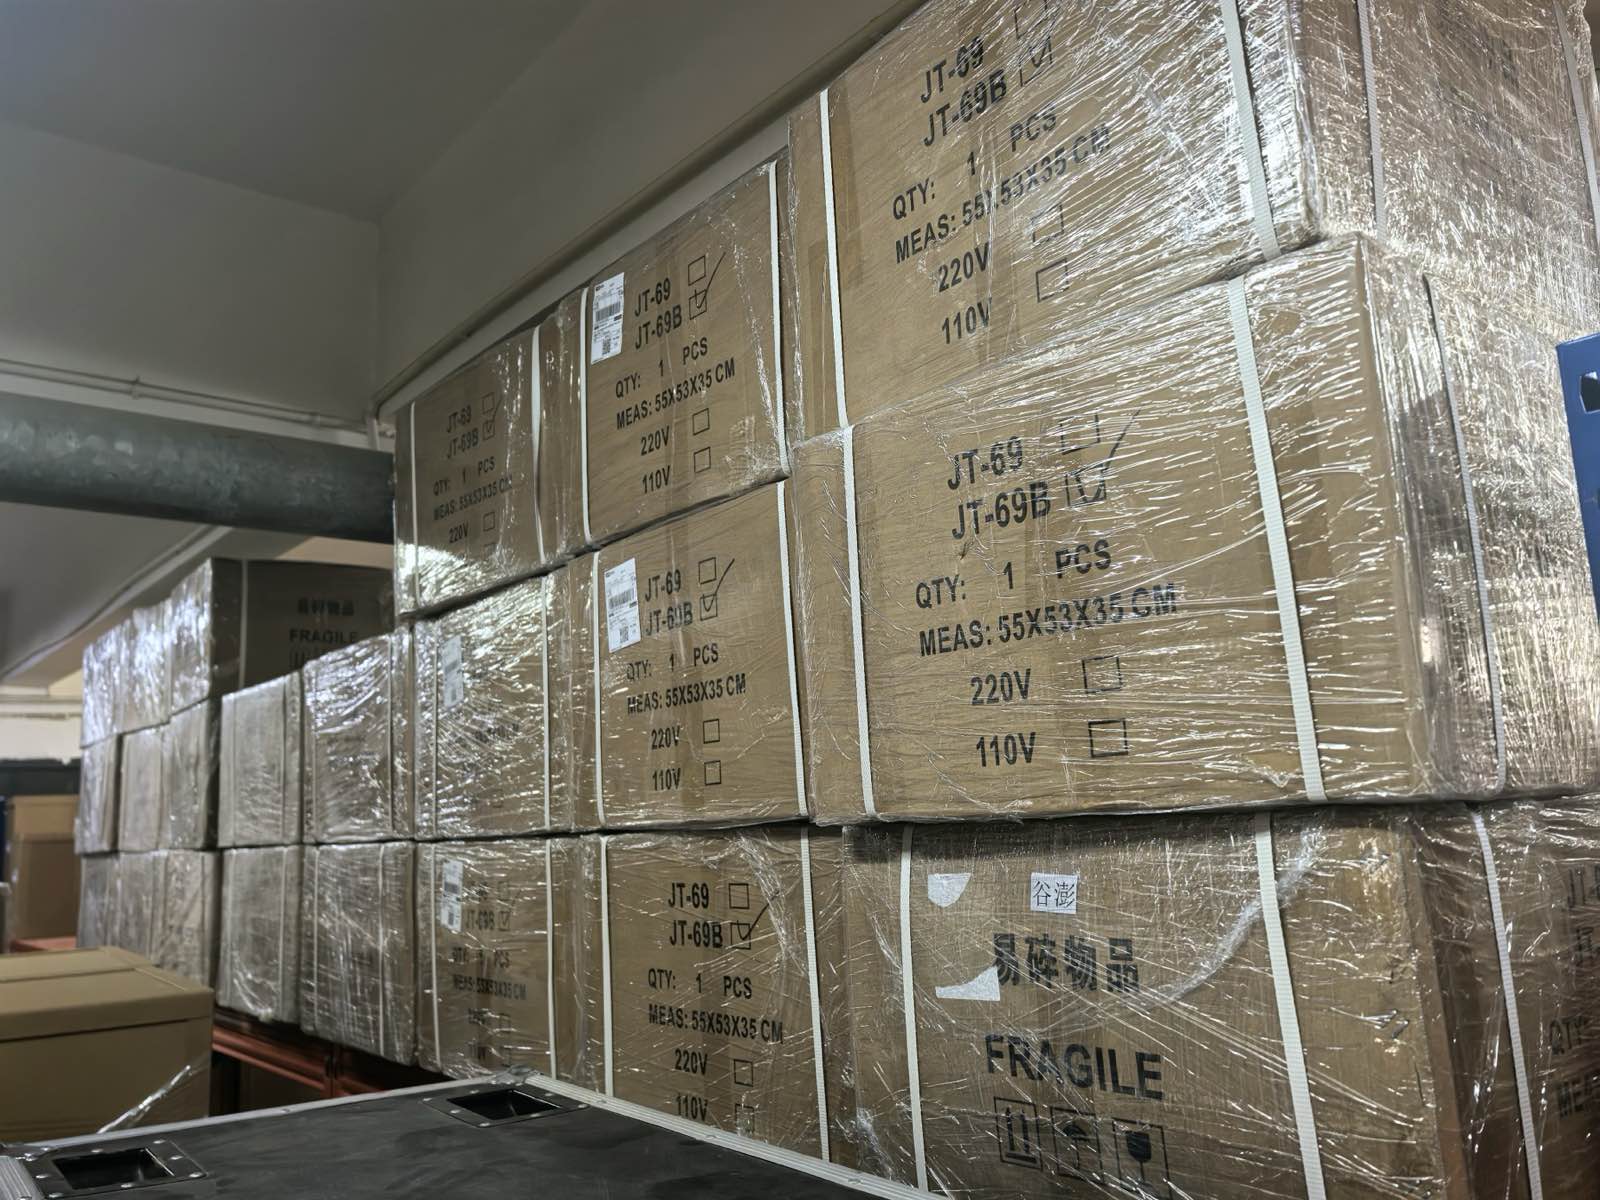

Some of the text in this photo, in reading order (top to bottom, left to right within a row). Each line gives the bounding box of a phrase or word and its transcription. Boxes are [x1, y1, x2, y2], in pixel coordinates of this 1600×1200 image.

[921, 36, 985, 103] JT-69
[923, 69, 1007, 147] JT-69B
[892, 105, 1056, 220] QTY: 1 PCS
[895, 213, 955, 264] MEAS:
[1072, 123, 1112, 164] CM
[938, 242, 989, 293] 220V
[634, 277, 671, 318] JT-69
[635, 304, 683, 350] JT-69B
[941, 299, 990, 345] 110V
[615, 337, 708, 399] QTY: 1 PCS
[616, 358, 736, 430] MEAS: 55X53X35 CM
[447, 405, 472, 433] JT-69
[447, 428, 479, 459] JT-69B
[640, 426, 671, 456] 220V
[462, 468, 467, 483] 1
[477, 456, 496, 476] PCS
[642, 465, 671, 494] 110V
[947, 435, 1024, 490] JT-69
[951, 480, 1051, 540] JT-69B
[449, 521, 469, 543] 220V
[644, 569, 681, 602] JT-69
[915, 538, 1112, 609] QTY: 1 PCS
[919, 582, 1177, 657] MEAS: 55X53X35 CM
[627, 642, 719, 680] QTY: 1 PCS
[627, 673, 747, 715] MEAS: 55X53X35 CM
[970, 668, 1032, 705] 220V
[651, 725, 681, 750] 220V
[976, 732, 1036, 767] 110V
[652, 767, 681, 791] 110V
[668, 882, 709, 908] JT-69
[1032, 880, 1076, 908] 谷澎
[669, 919, 724, 949] JT-69B
[992, 932, 1140, 993] 易碎物品
[648, 967, 753, 1000] QTY: 1 PCS
[649, 1004, 783, 1044] MEAS: 55X53X35 CM
[674, 1048, 708, 1076] 220V
[985, 1033, 1165, 1101] FRAGILE
[675, 1093, 708, 1122] 110V
